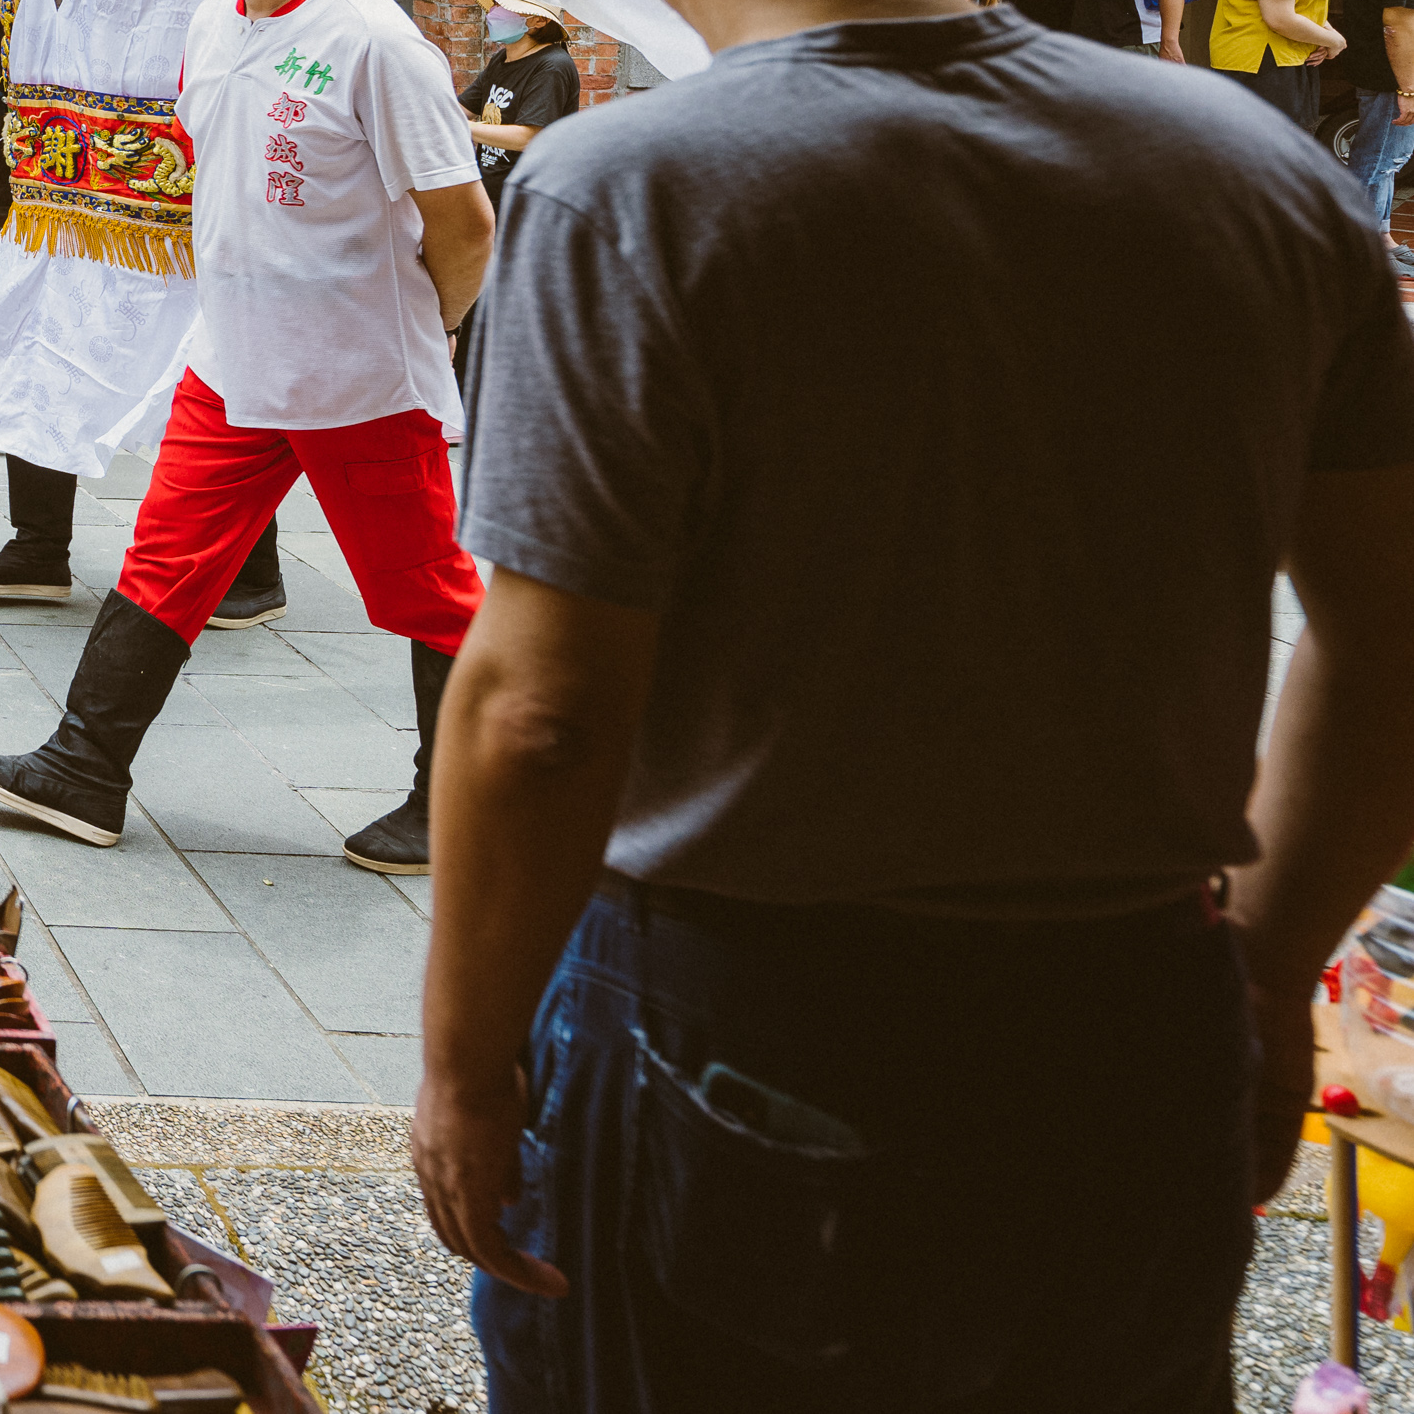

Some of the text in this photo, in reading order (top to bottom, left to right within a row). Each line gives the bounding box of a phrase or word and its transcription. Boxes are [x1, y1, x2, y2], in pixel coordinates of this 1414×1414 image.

[274, 47, 334, 95] 新竹
[265, 91, 307, 206] 都城隍
